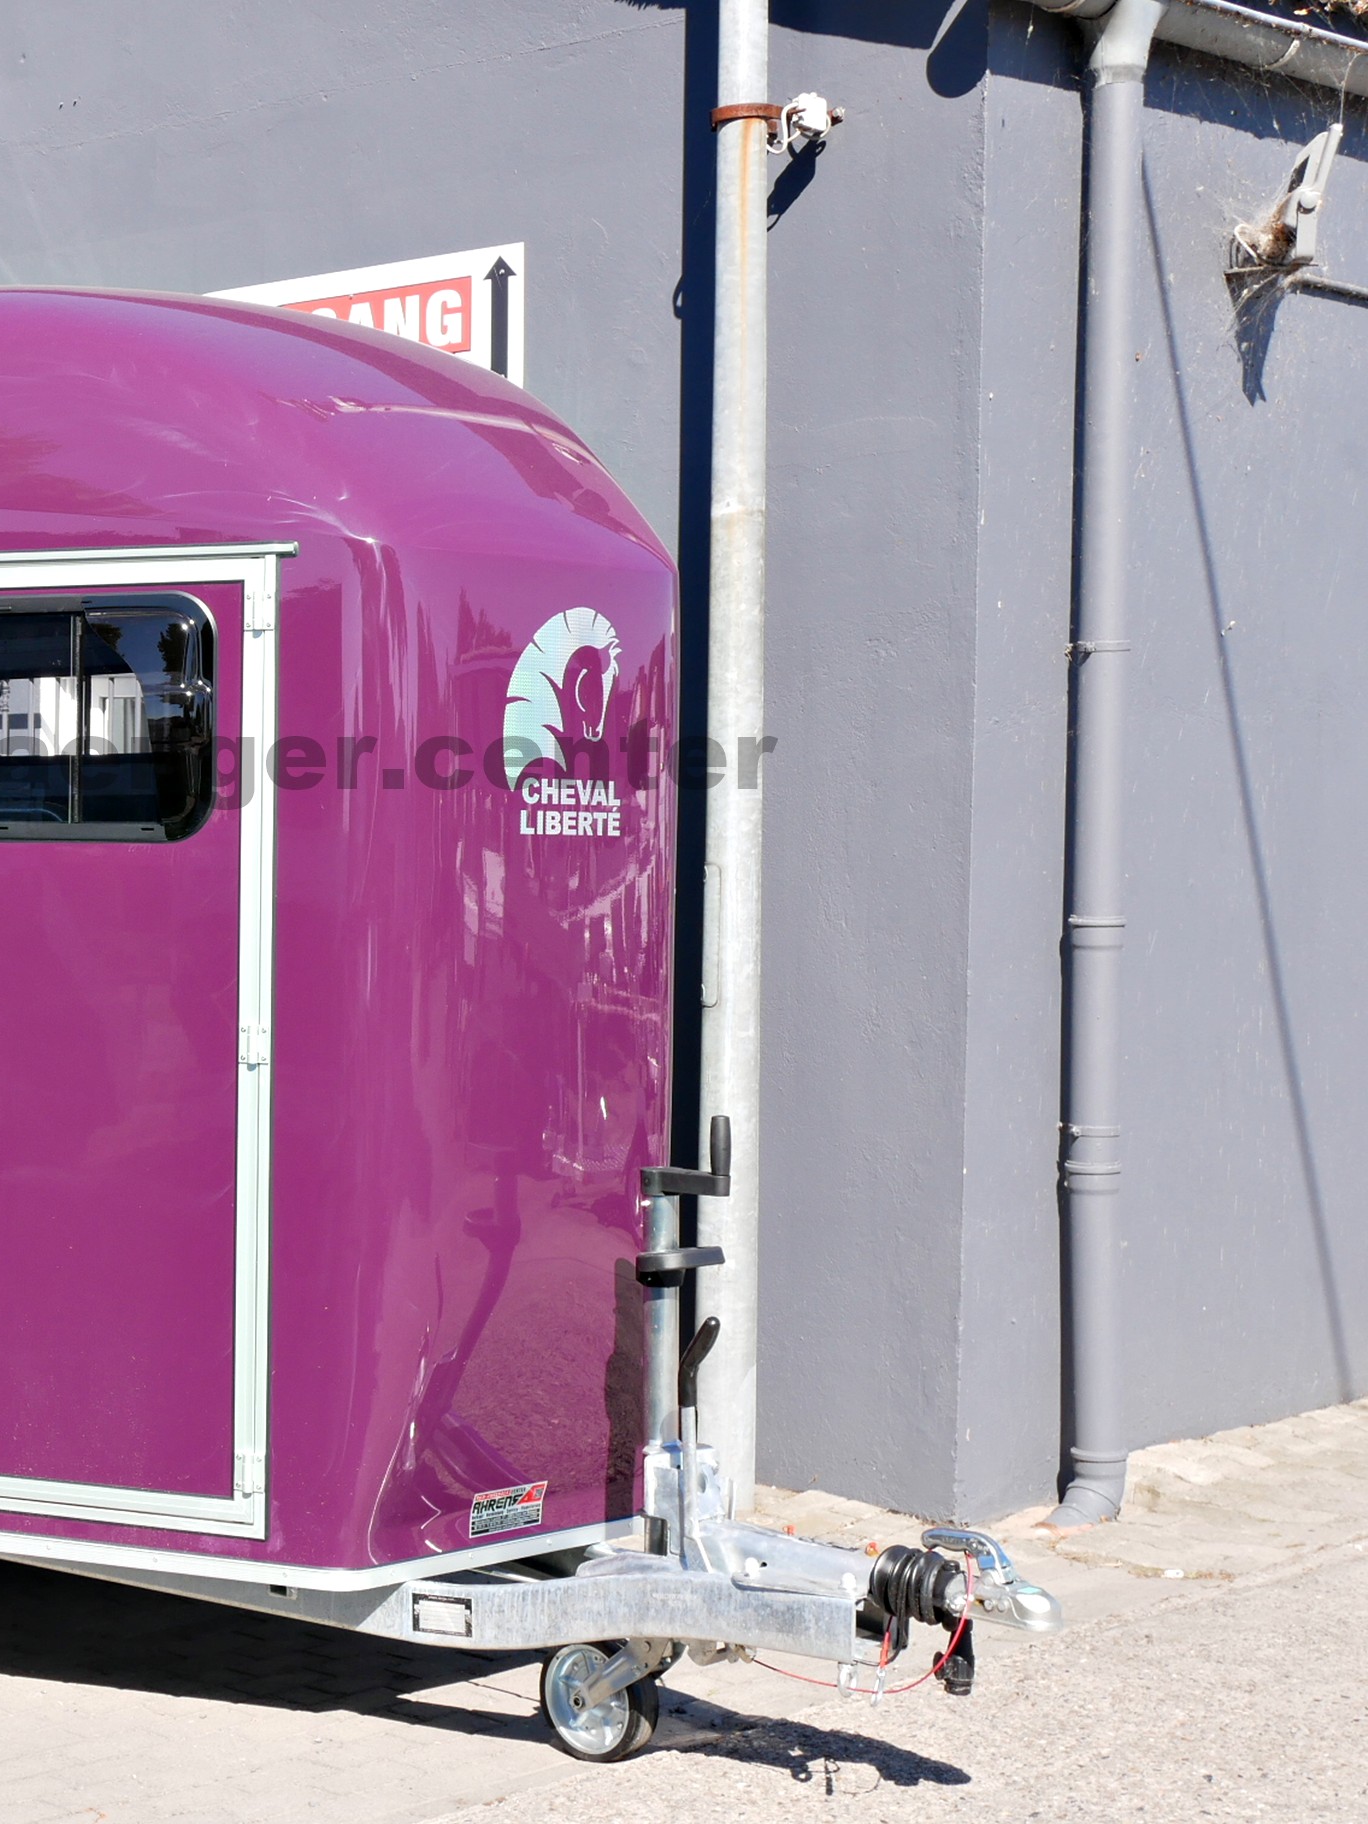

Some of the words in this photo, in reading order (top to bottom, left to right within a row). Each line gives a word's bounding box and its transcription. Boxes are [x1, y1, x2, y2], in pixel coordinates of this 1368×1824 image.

[522, 777, 621, 806] CHEVAL
[520, 807, 621, 836] LIBERTÉ
[472, 1494, 523, 1514] AHRENS
